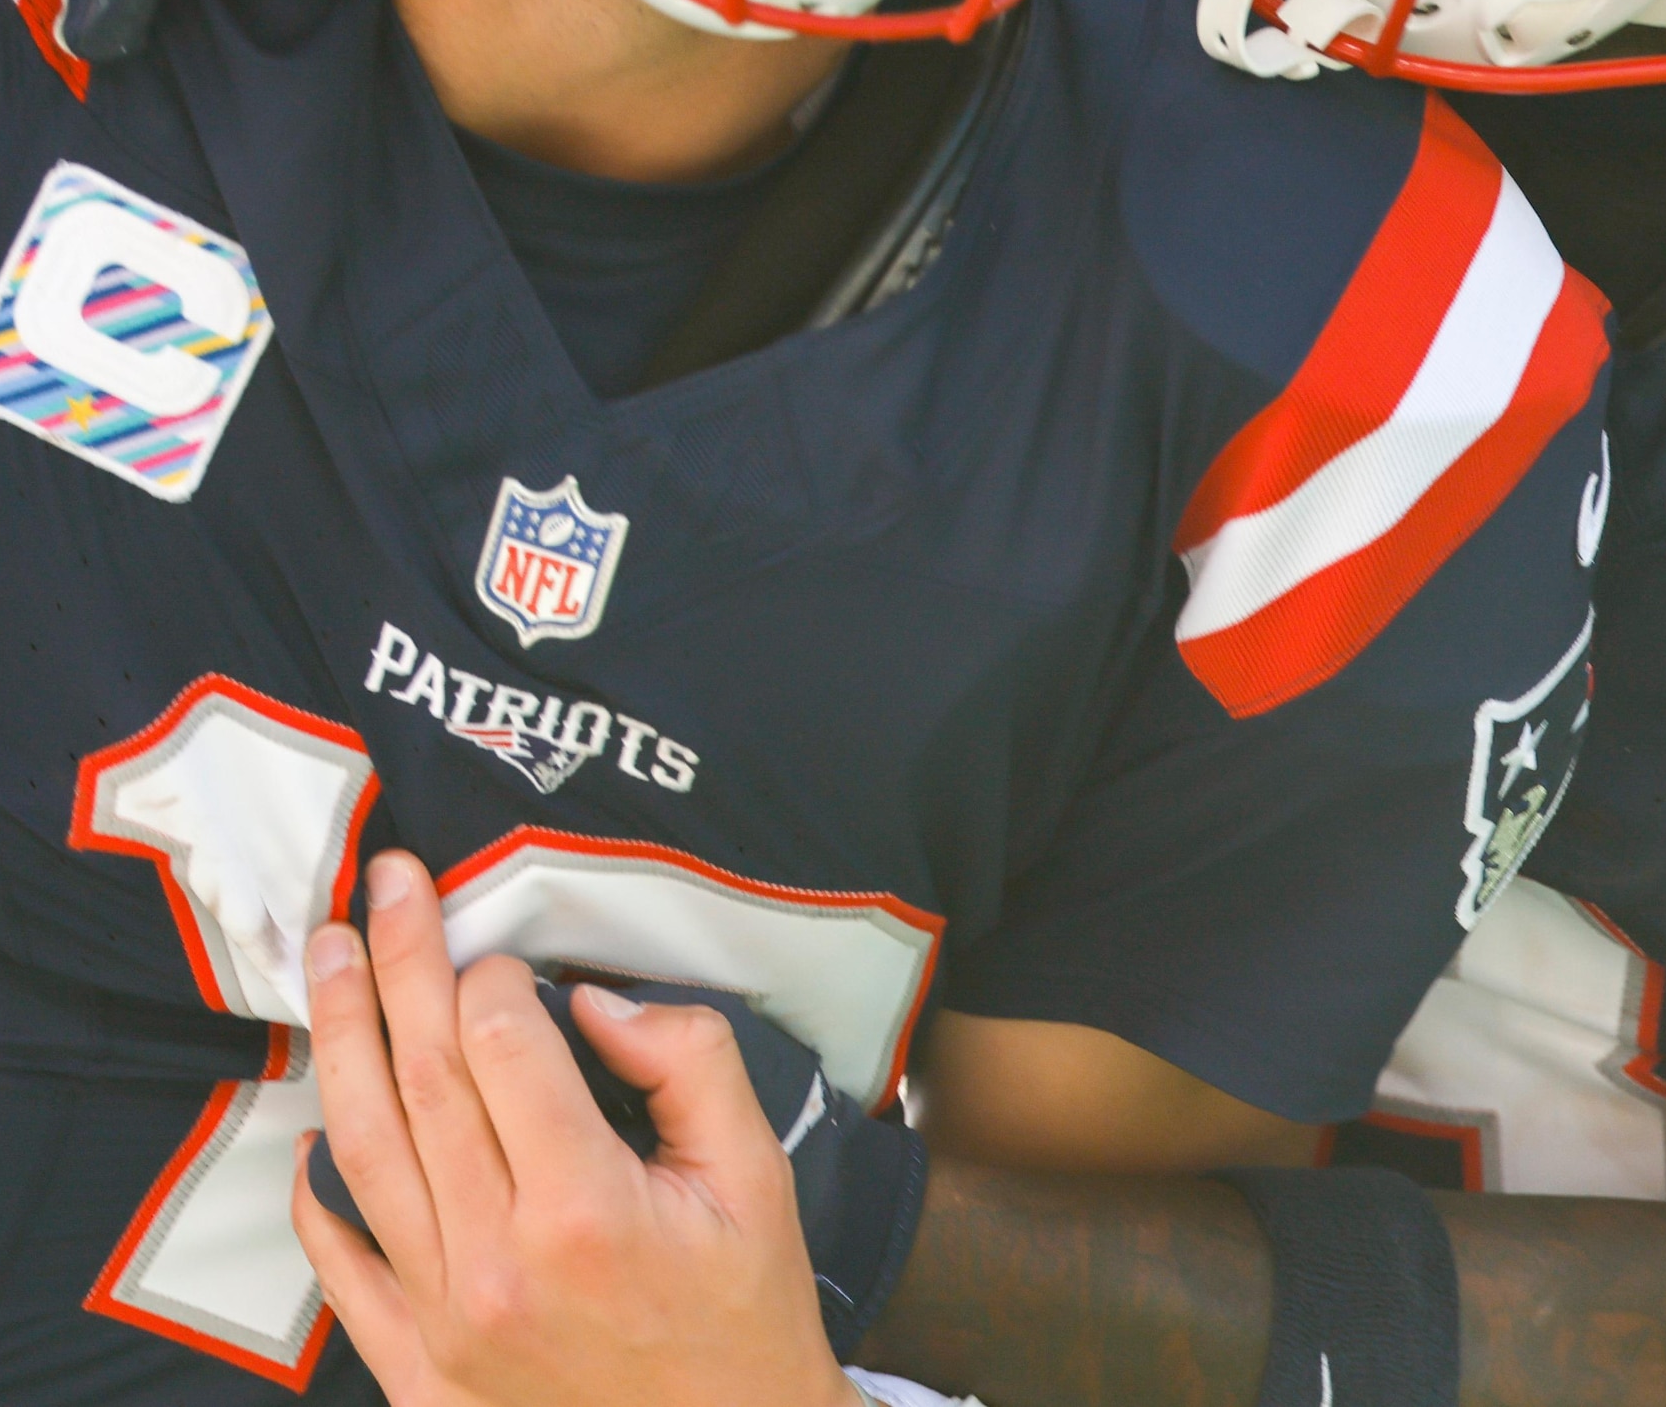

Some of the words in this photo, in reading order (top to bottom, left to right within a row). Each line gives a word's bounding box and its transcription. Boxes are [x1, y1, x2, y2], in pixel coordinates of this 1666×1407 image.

[13, 199, 252, 417] C
[495, 544, 582, 619] NFL
[364, 620, 702, 793] PATRIOTS
